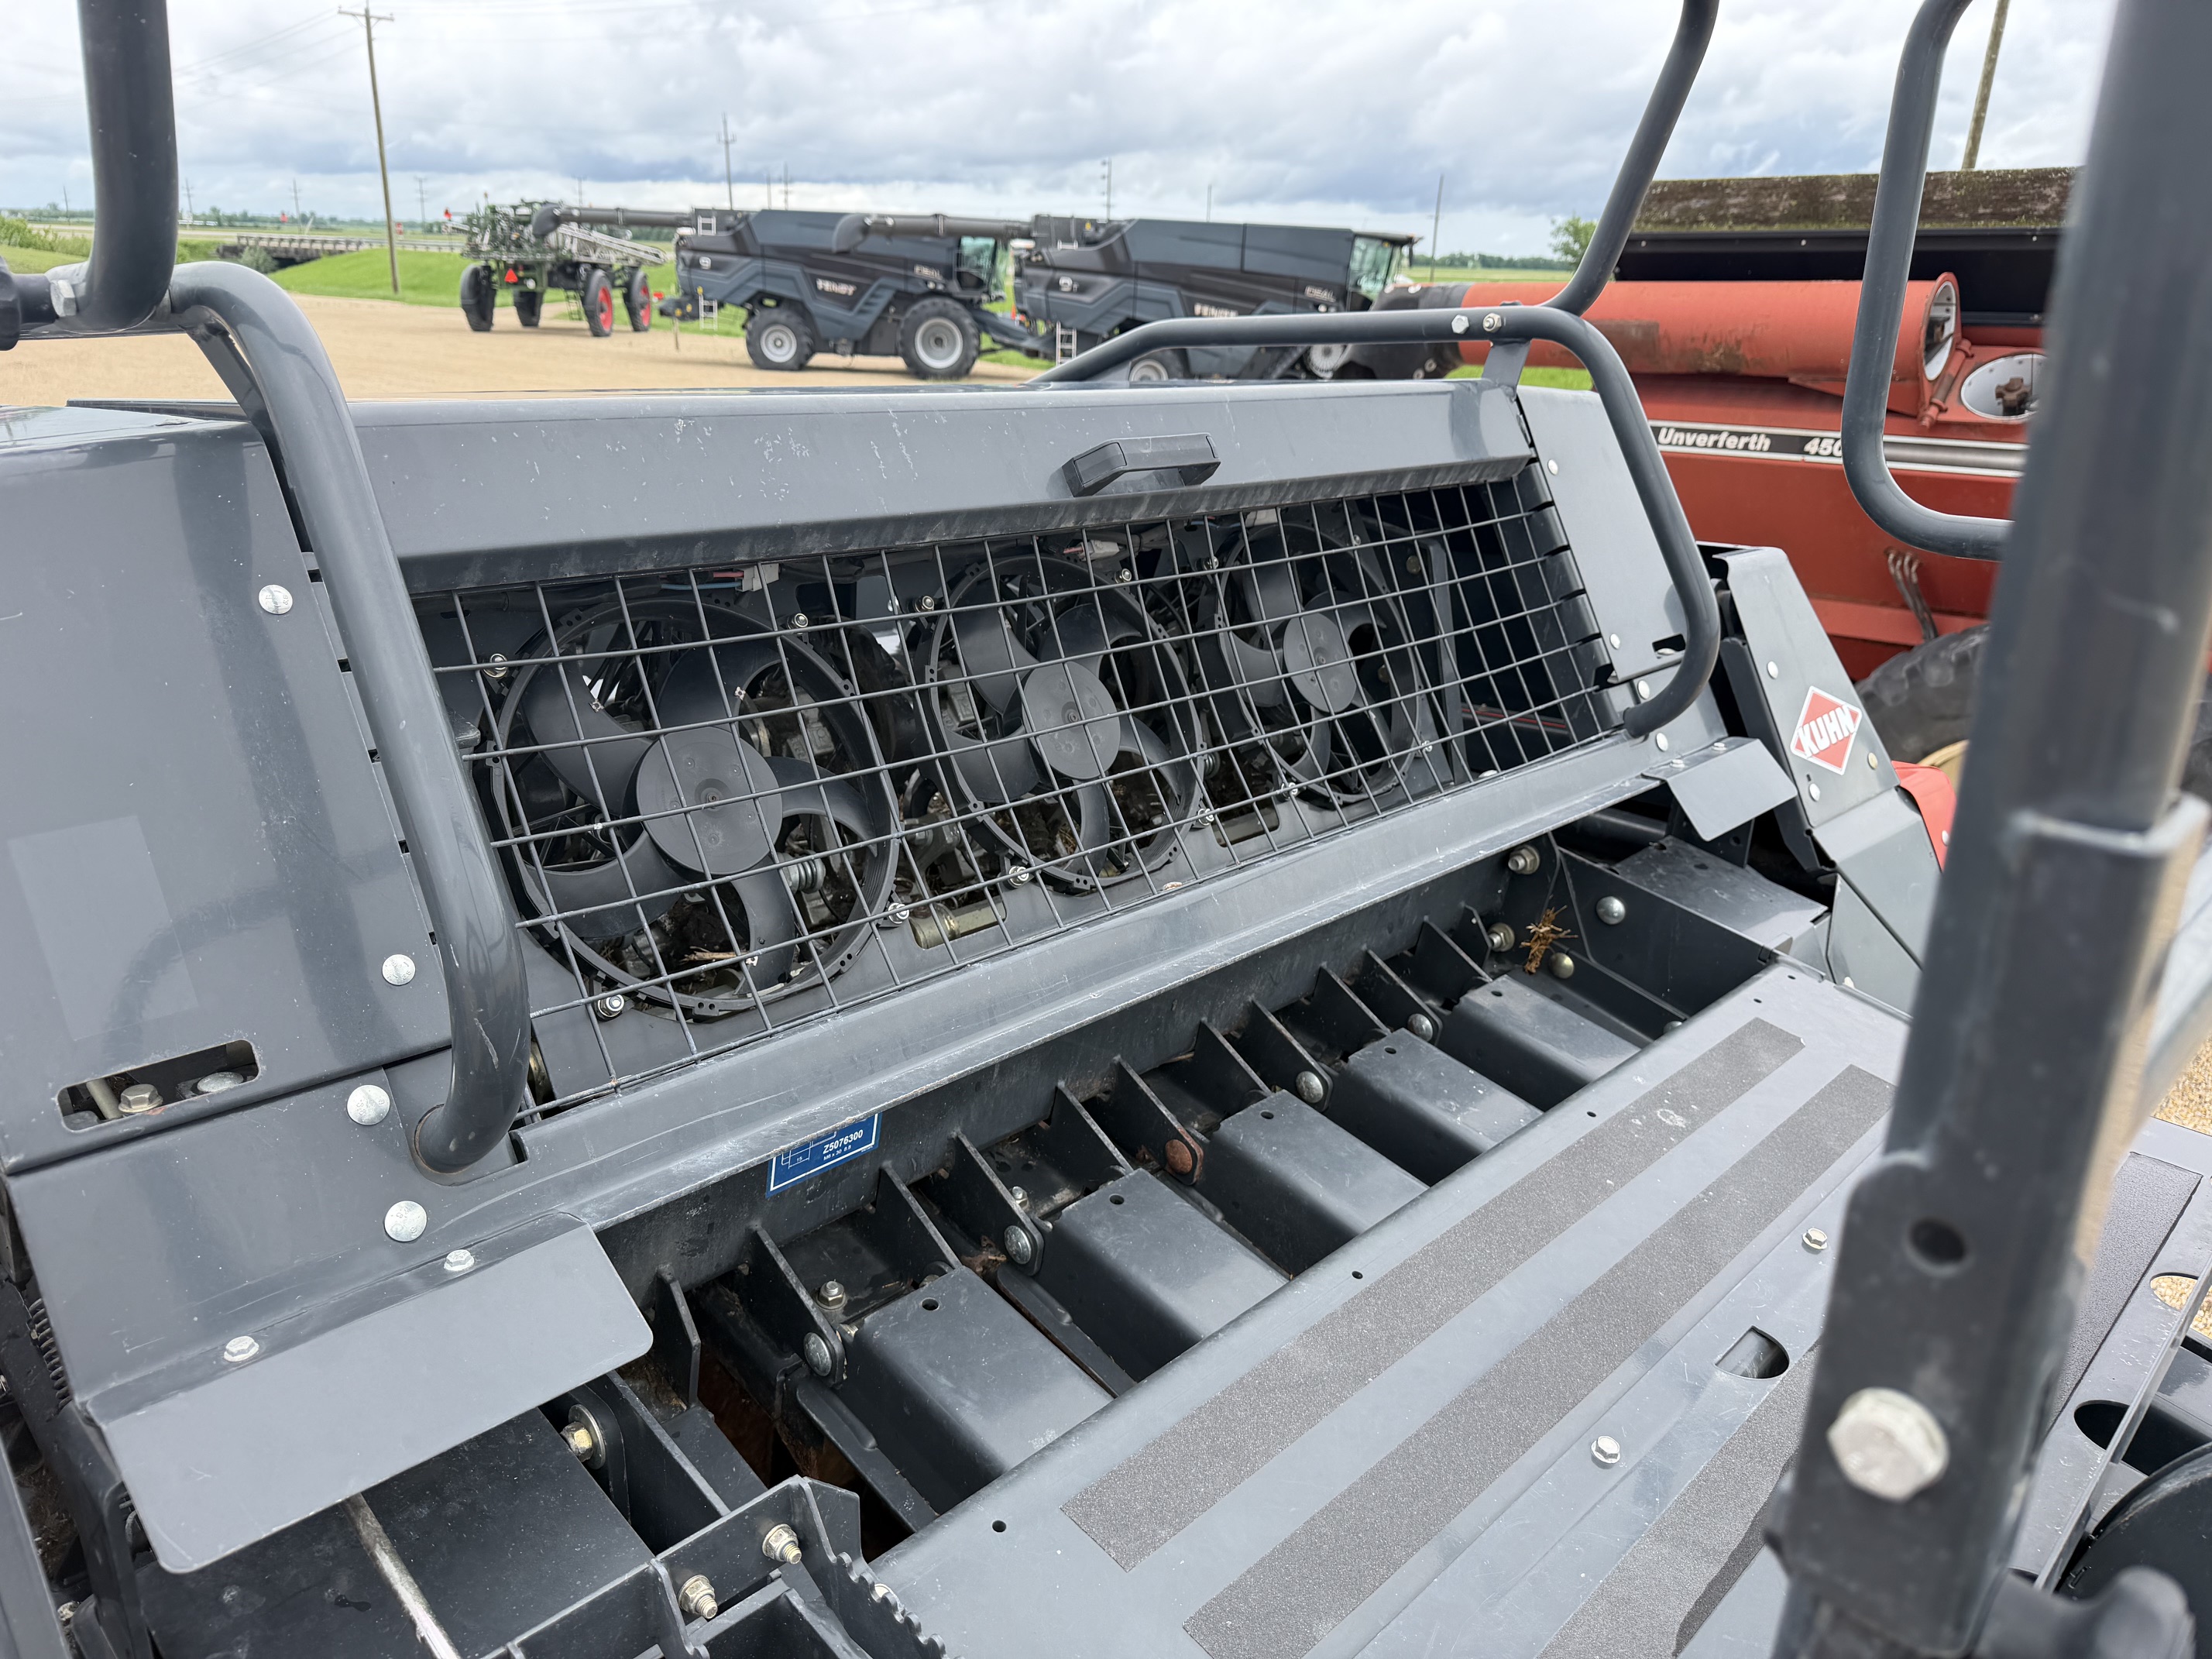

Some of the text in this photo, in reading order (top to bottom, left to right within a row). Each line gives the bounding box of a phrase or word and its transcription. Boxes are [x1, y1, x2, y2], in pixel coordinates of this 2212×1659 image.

[1304, 285, 1336, 302] IDEAL
[1657, 428, 1771, 452] Unverferth
[1798, 704, 1856, 757] KUHN
[823, 1129, 864, 1154] Z5076300
